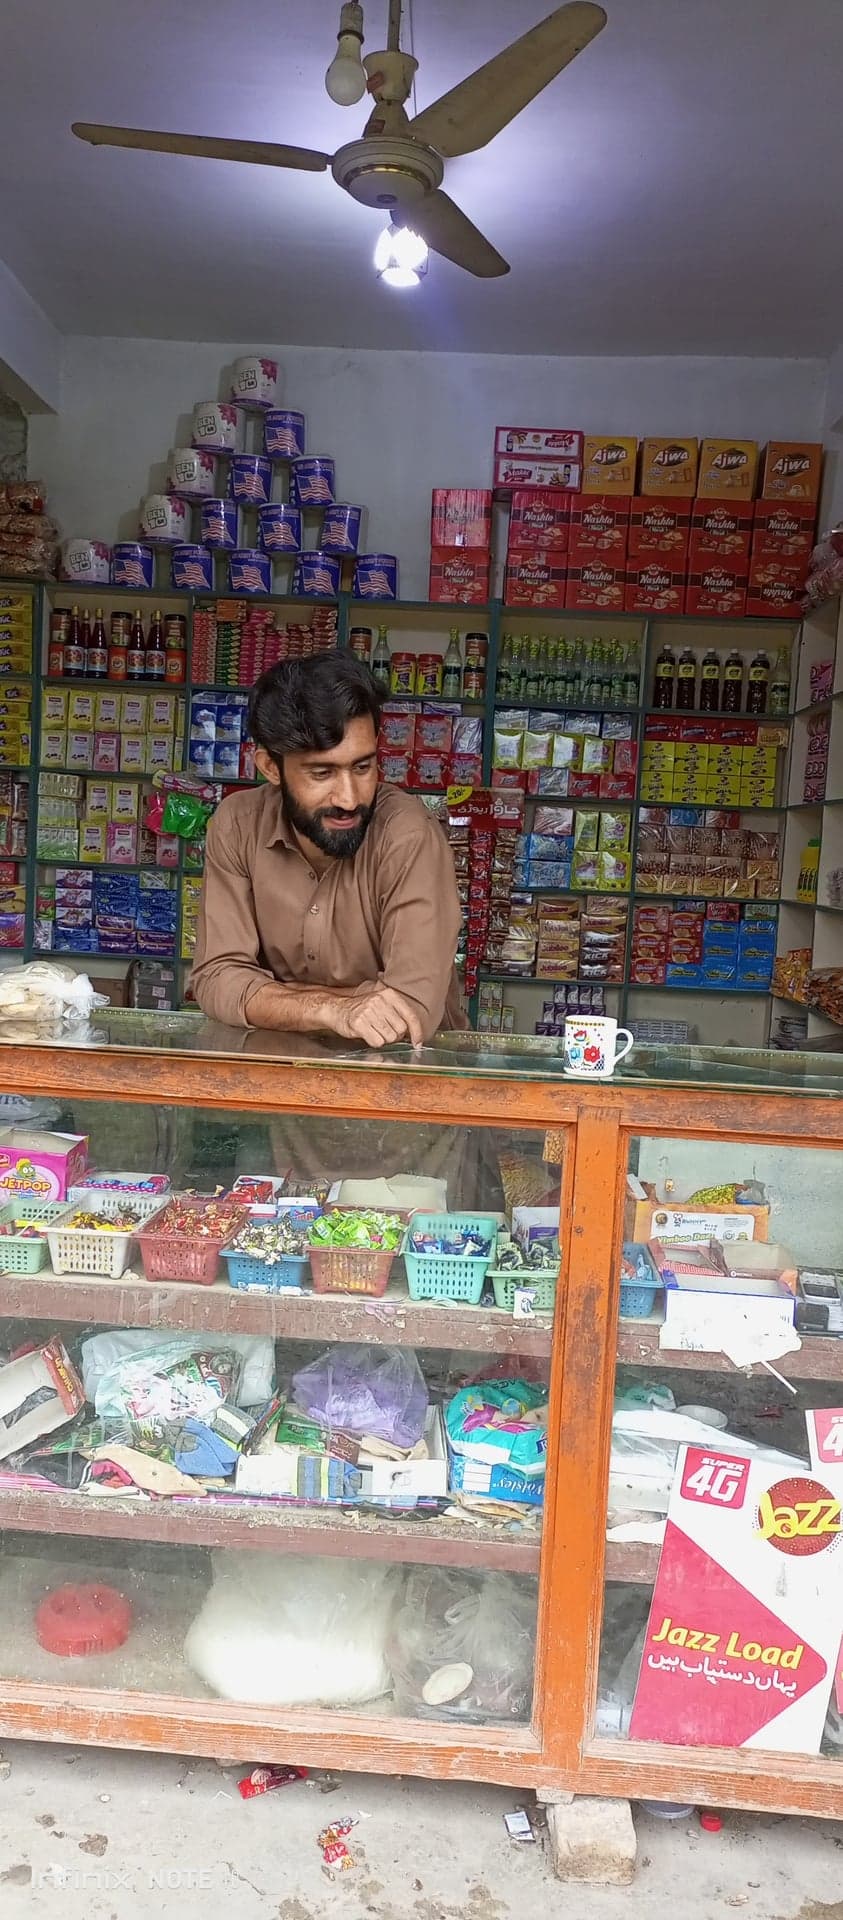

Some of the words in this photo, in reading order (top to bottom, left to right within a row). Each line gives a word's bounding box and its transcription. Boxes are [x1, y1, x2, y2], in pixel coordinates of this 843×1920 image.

[592, 448, 627, 465] Ajwa
[653, 450, 689, 467] Ajwa
[711, 453, 747, 470] Ajwa
[772, 458, 810, 475] Ajwa
[523, 510, 554, 522] Nashta
[583, 512, 614, 525] Nashta
[644, 515, 675, 527] Nashta
[705, 517, 736, 530] Nashta
[768, 518, 798, 530] Nashta
[518, 566, 548, 579] Nashta
[582, 569, 613, 581] Nashta
[639, 573, 670, 585] Nashta
[703, 575, 734, 587] Nashta
[0, 1177, 51, 1191] JETPOP
[701, 1457, 745, 1472] SUPER
[686, 1466, 743, 1503] 4G
[754, 1492, 843, 1539] Jazz
[652, 1617, 720, 1653] Jazz
[725, 1632, 804, 1670] Load
[754, 1670, 797, 1697] یہاں
